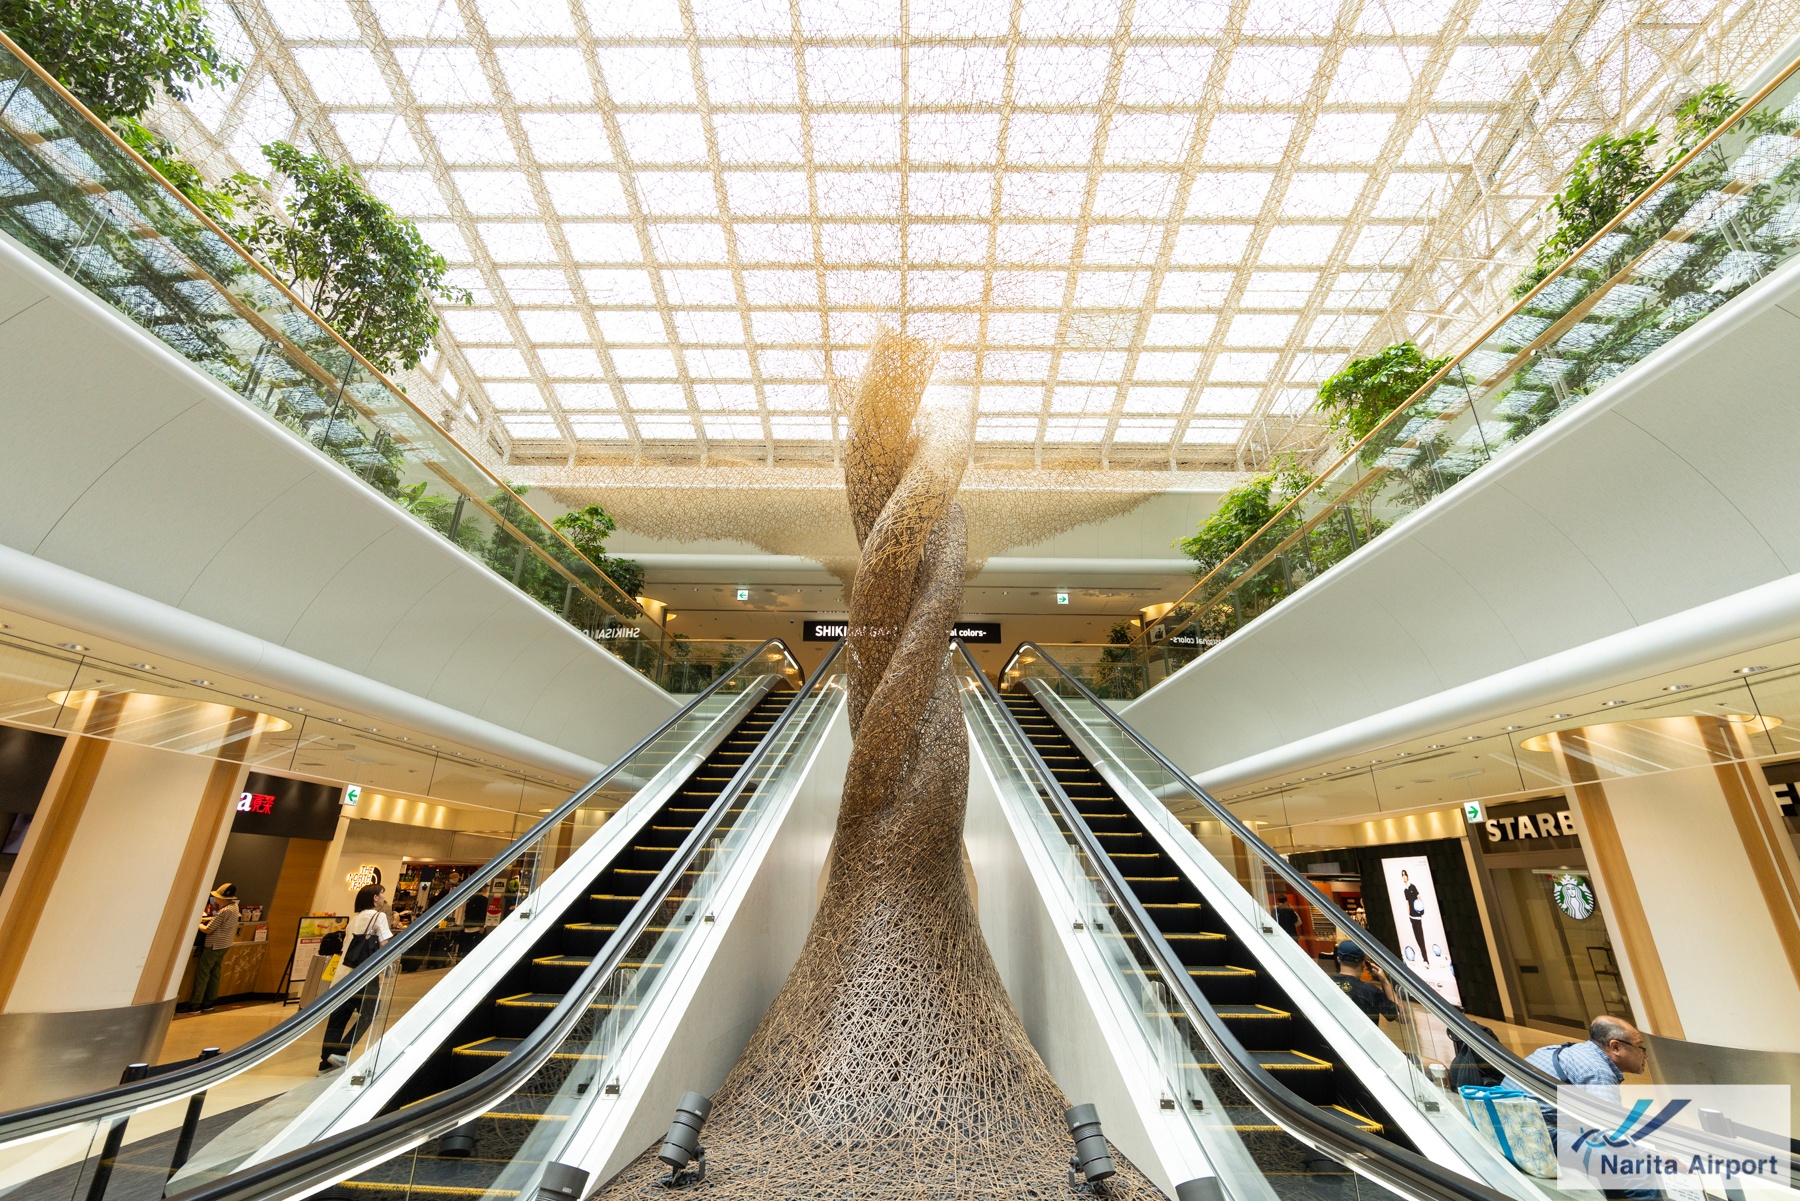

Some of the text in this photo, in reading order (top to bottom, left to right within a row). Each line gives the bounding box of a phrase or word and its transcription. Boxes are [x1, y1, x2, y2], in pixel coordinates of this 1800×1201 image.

[1769, 781, 1800, 817] F
[1485, 810, 1578, 842] STARB
[347, 873, 372, 882] NORTH
[361, 865, 374, 874] THE
